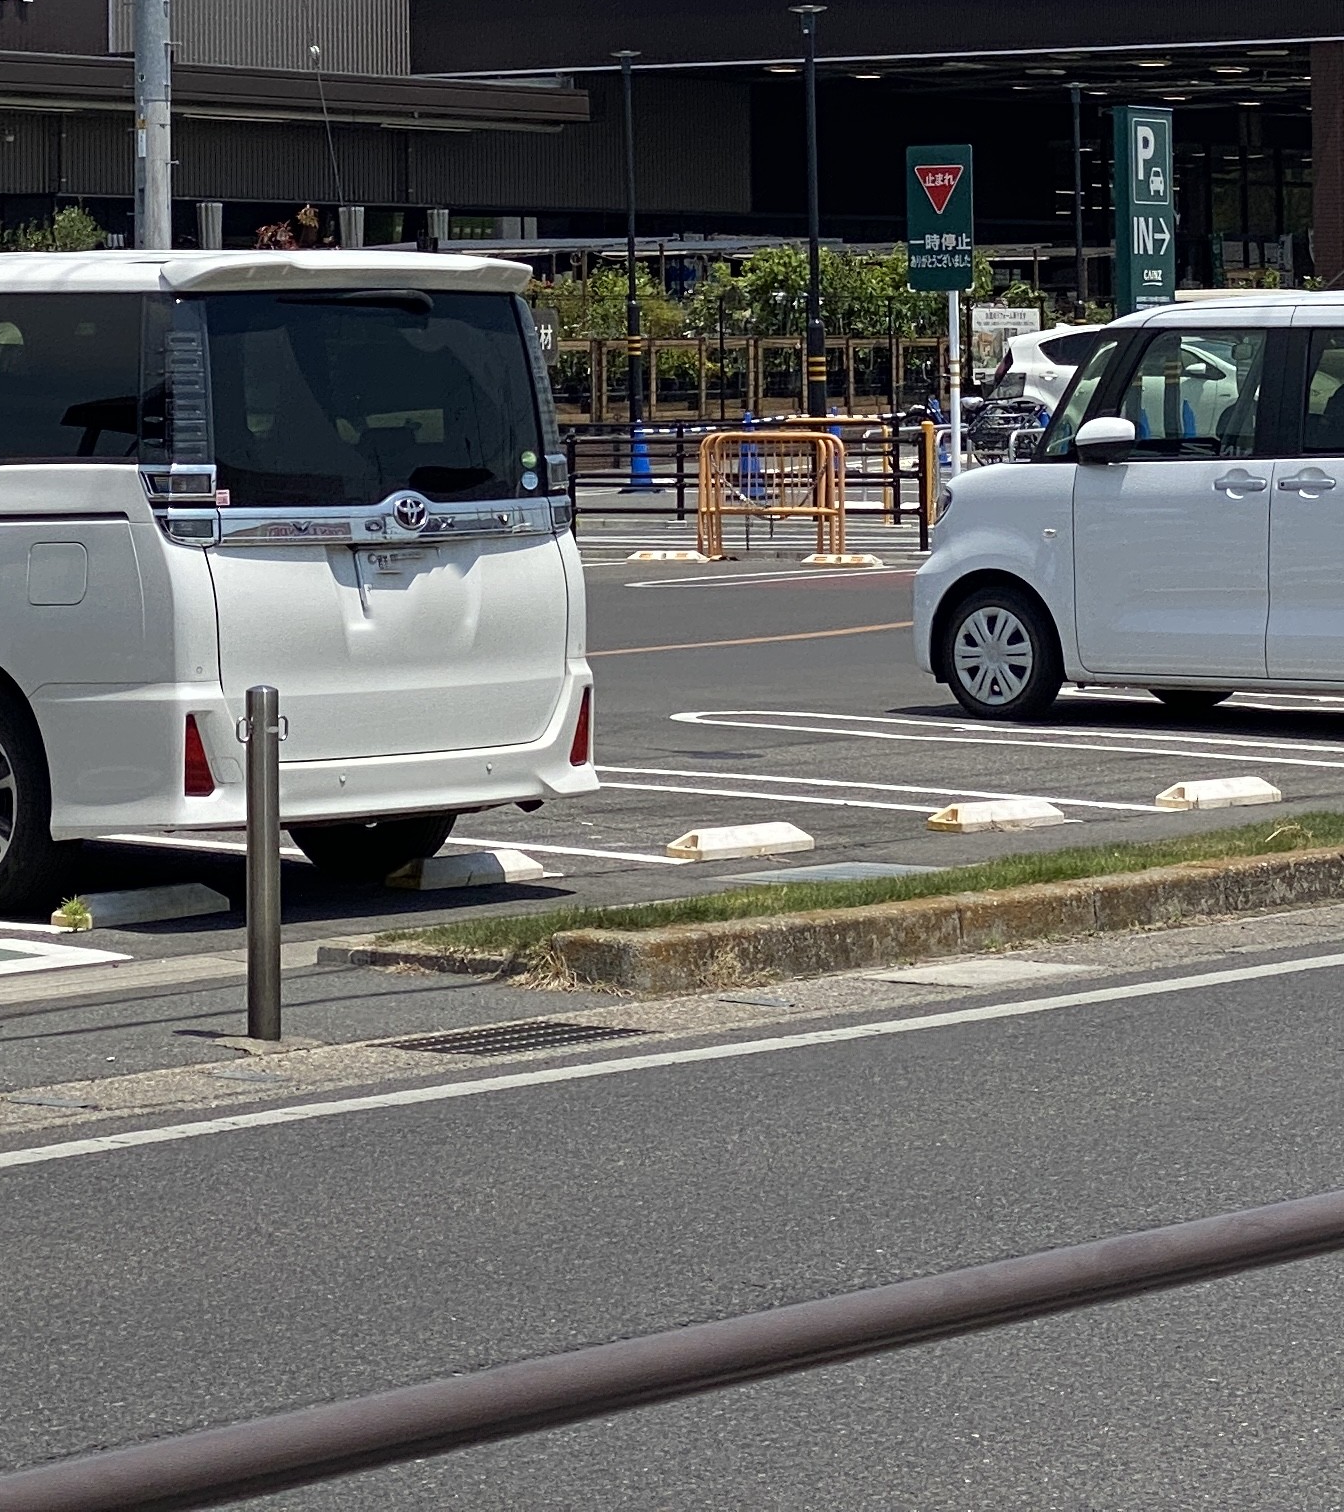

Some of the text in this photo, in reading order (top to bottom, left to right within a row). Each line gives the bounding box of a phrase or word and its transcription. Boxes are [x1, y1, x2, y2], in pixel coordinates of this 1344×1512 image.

[1136, 125, 1155, 180] P
[925, 172, 955, 187] 止まれ
[909, 232, 972, 251] 一時停止
[1133, 216, 1154, 255] IN
